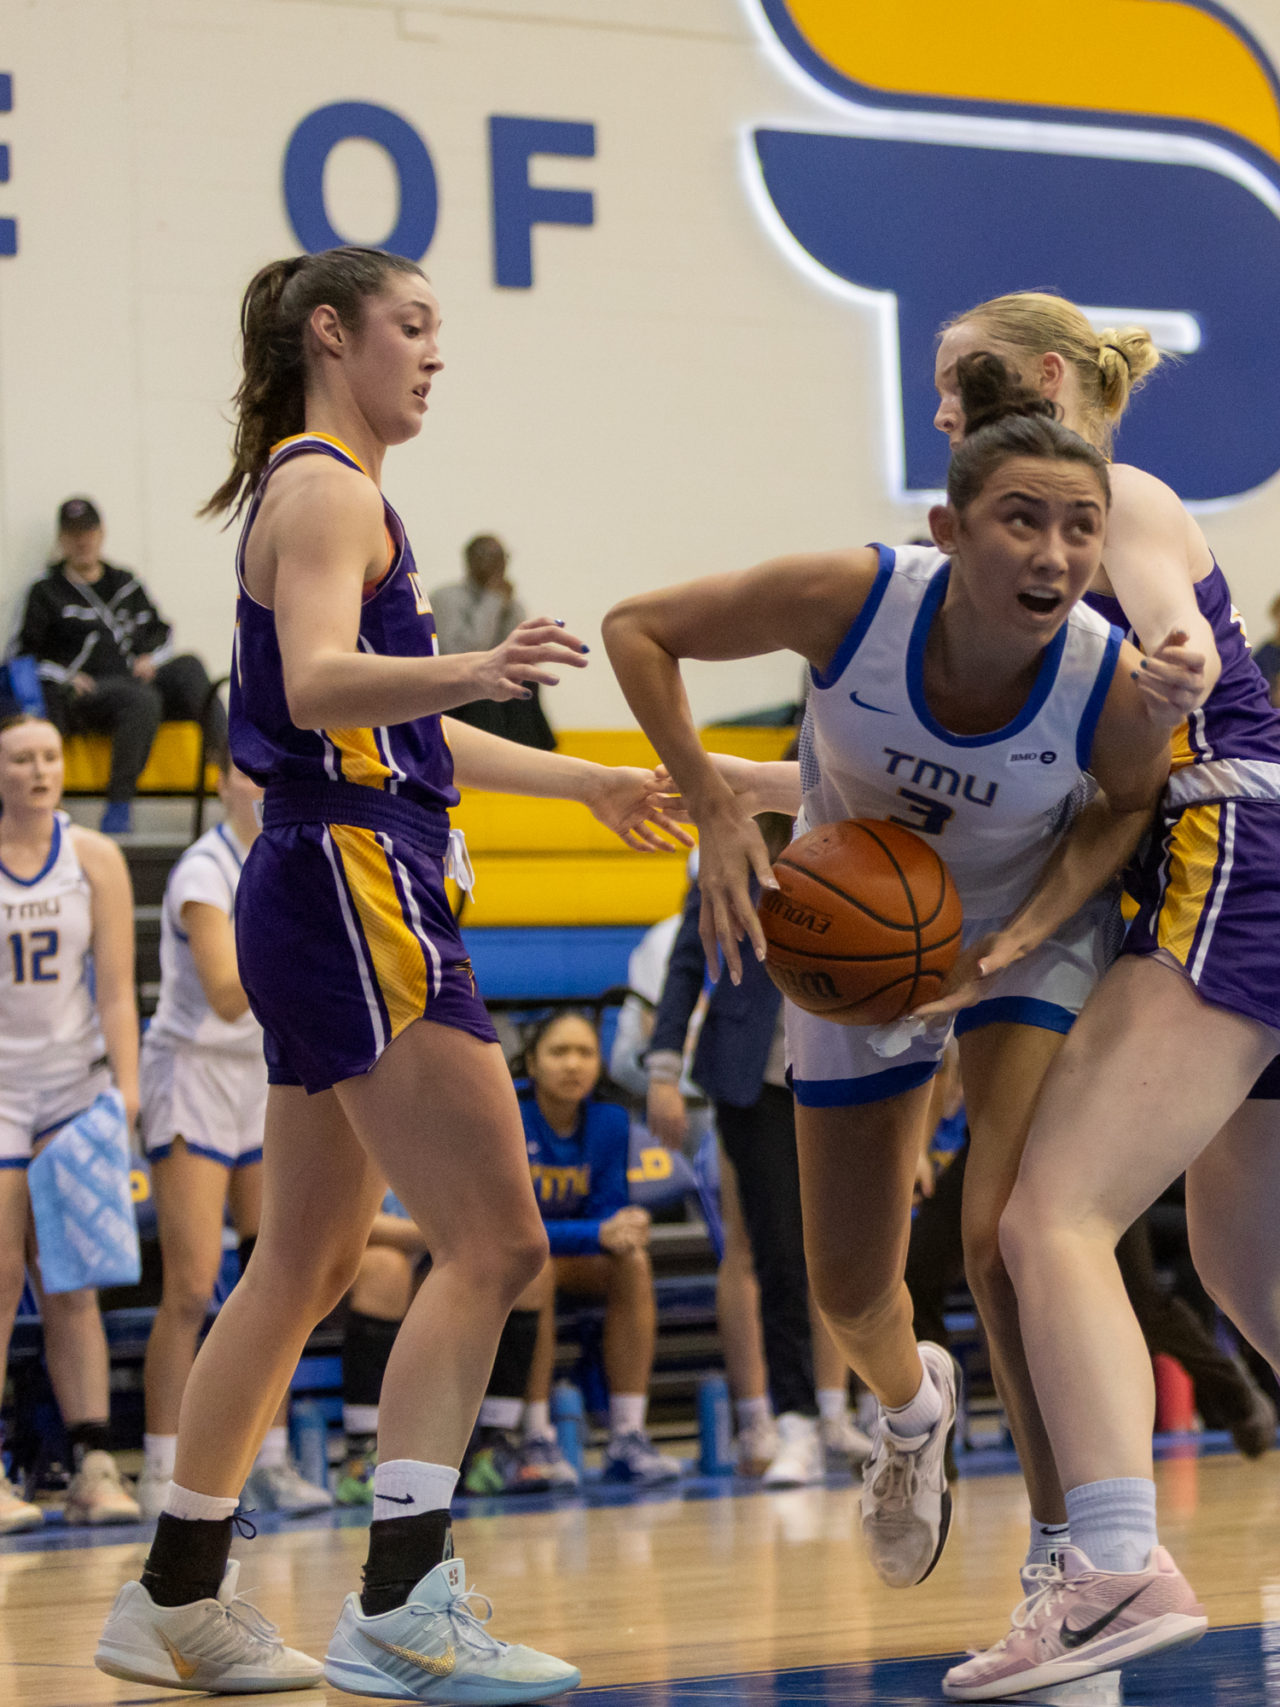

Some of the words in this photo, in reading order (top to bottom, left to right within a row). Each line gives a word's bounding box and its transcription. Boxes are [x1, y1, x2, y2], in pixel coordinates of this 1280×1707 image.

[283, 101, 596, 289] OF
[883, 746, 998, 808] TMU
[1009, 752, 1037, 763] BMO
[888, 786, 955, 835] 3
[3, 898, 60, 919] TMU
[8, 929, 60, 984] 12
